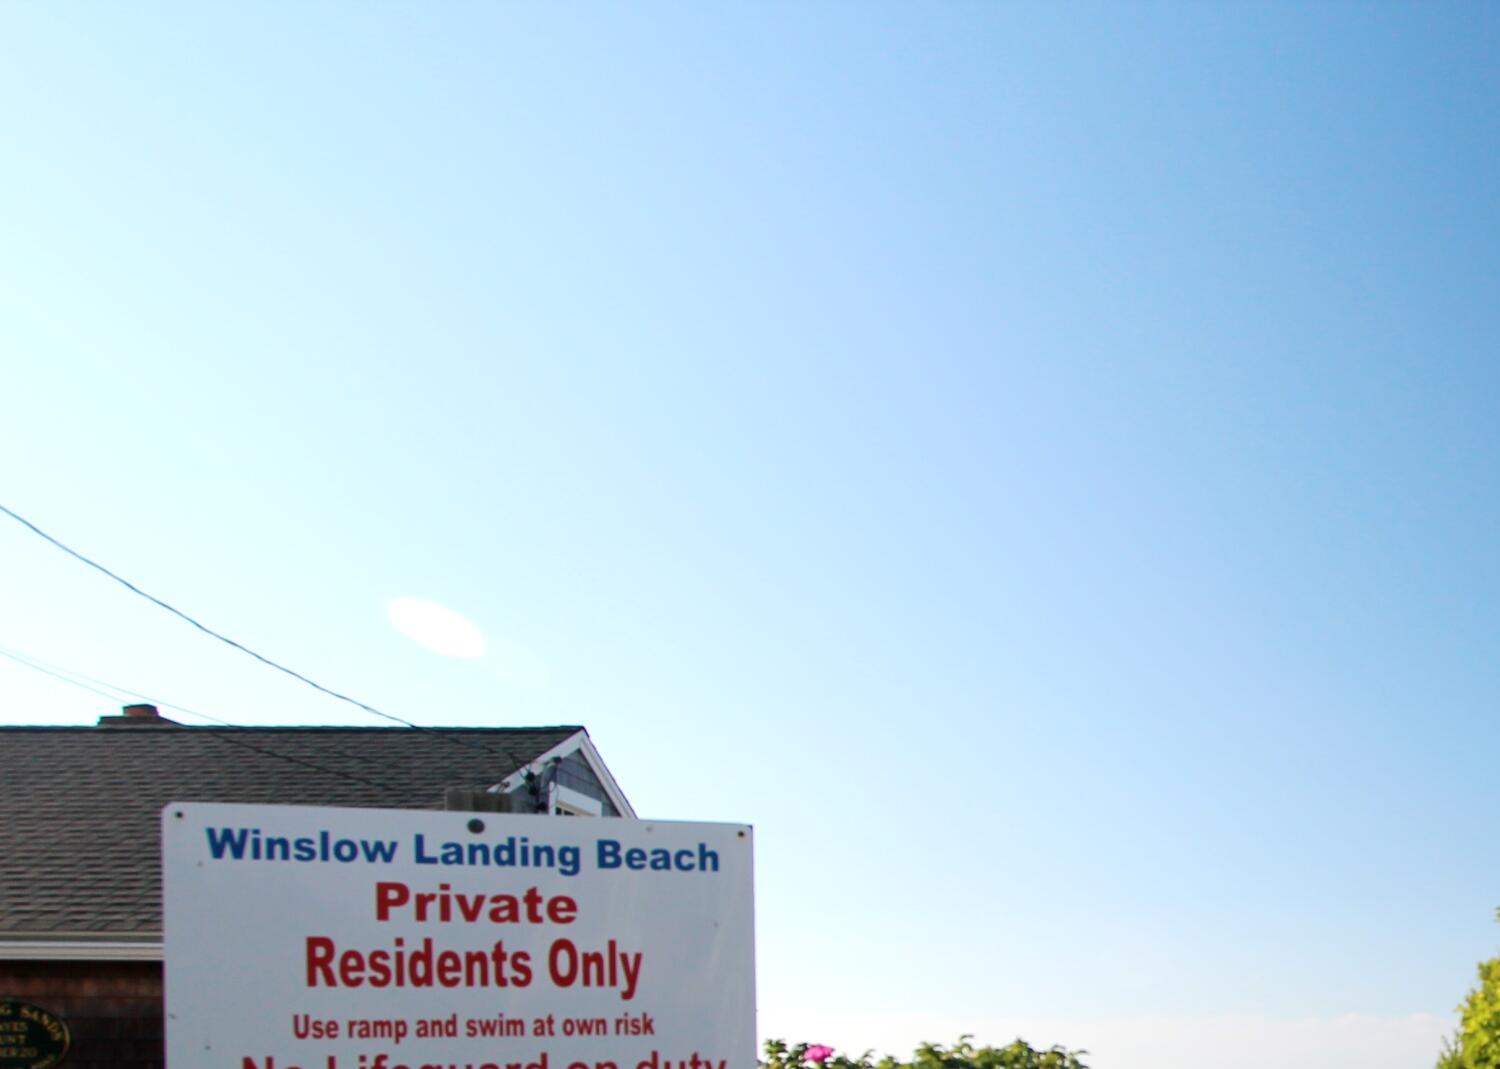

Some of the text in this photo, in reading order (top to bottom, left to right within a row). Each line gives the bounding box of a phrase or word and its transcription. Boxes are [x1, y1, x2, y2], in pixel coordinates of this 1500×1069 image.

[206, 828, 719, 876] Winslow Landing Beach
[376, 882, 578, 924] Private
[306, 937, 643, 1000] Residents Only
[294, 1013, 655, 1043] Use ramp and swim at own risk
